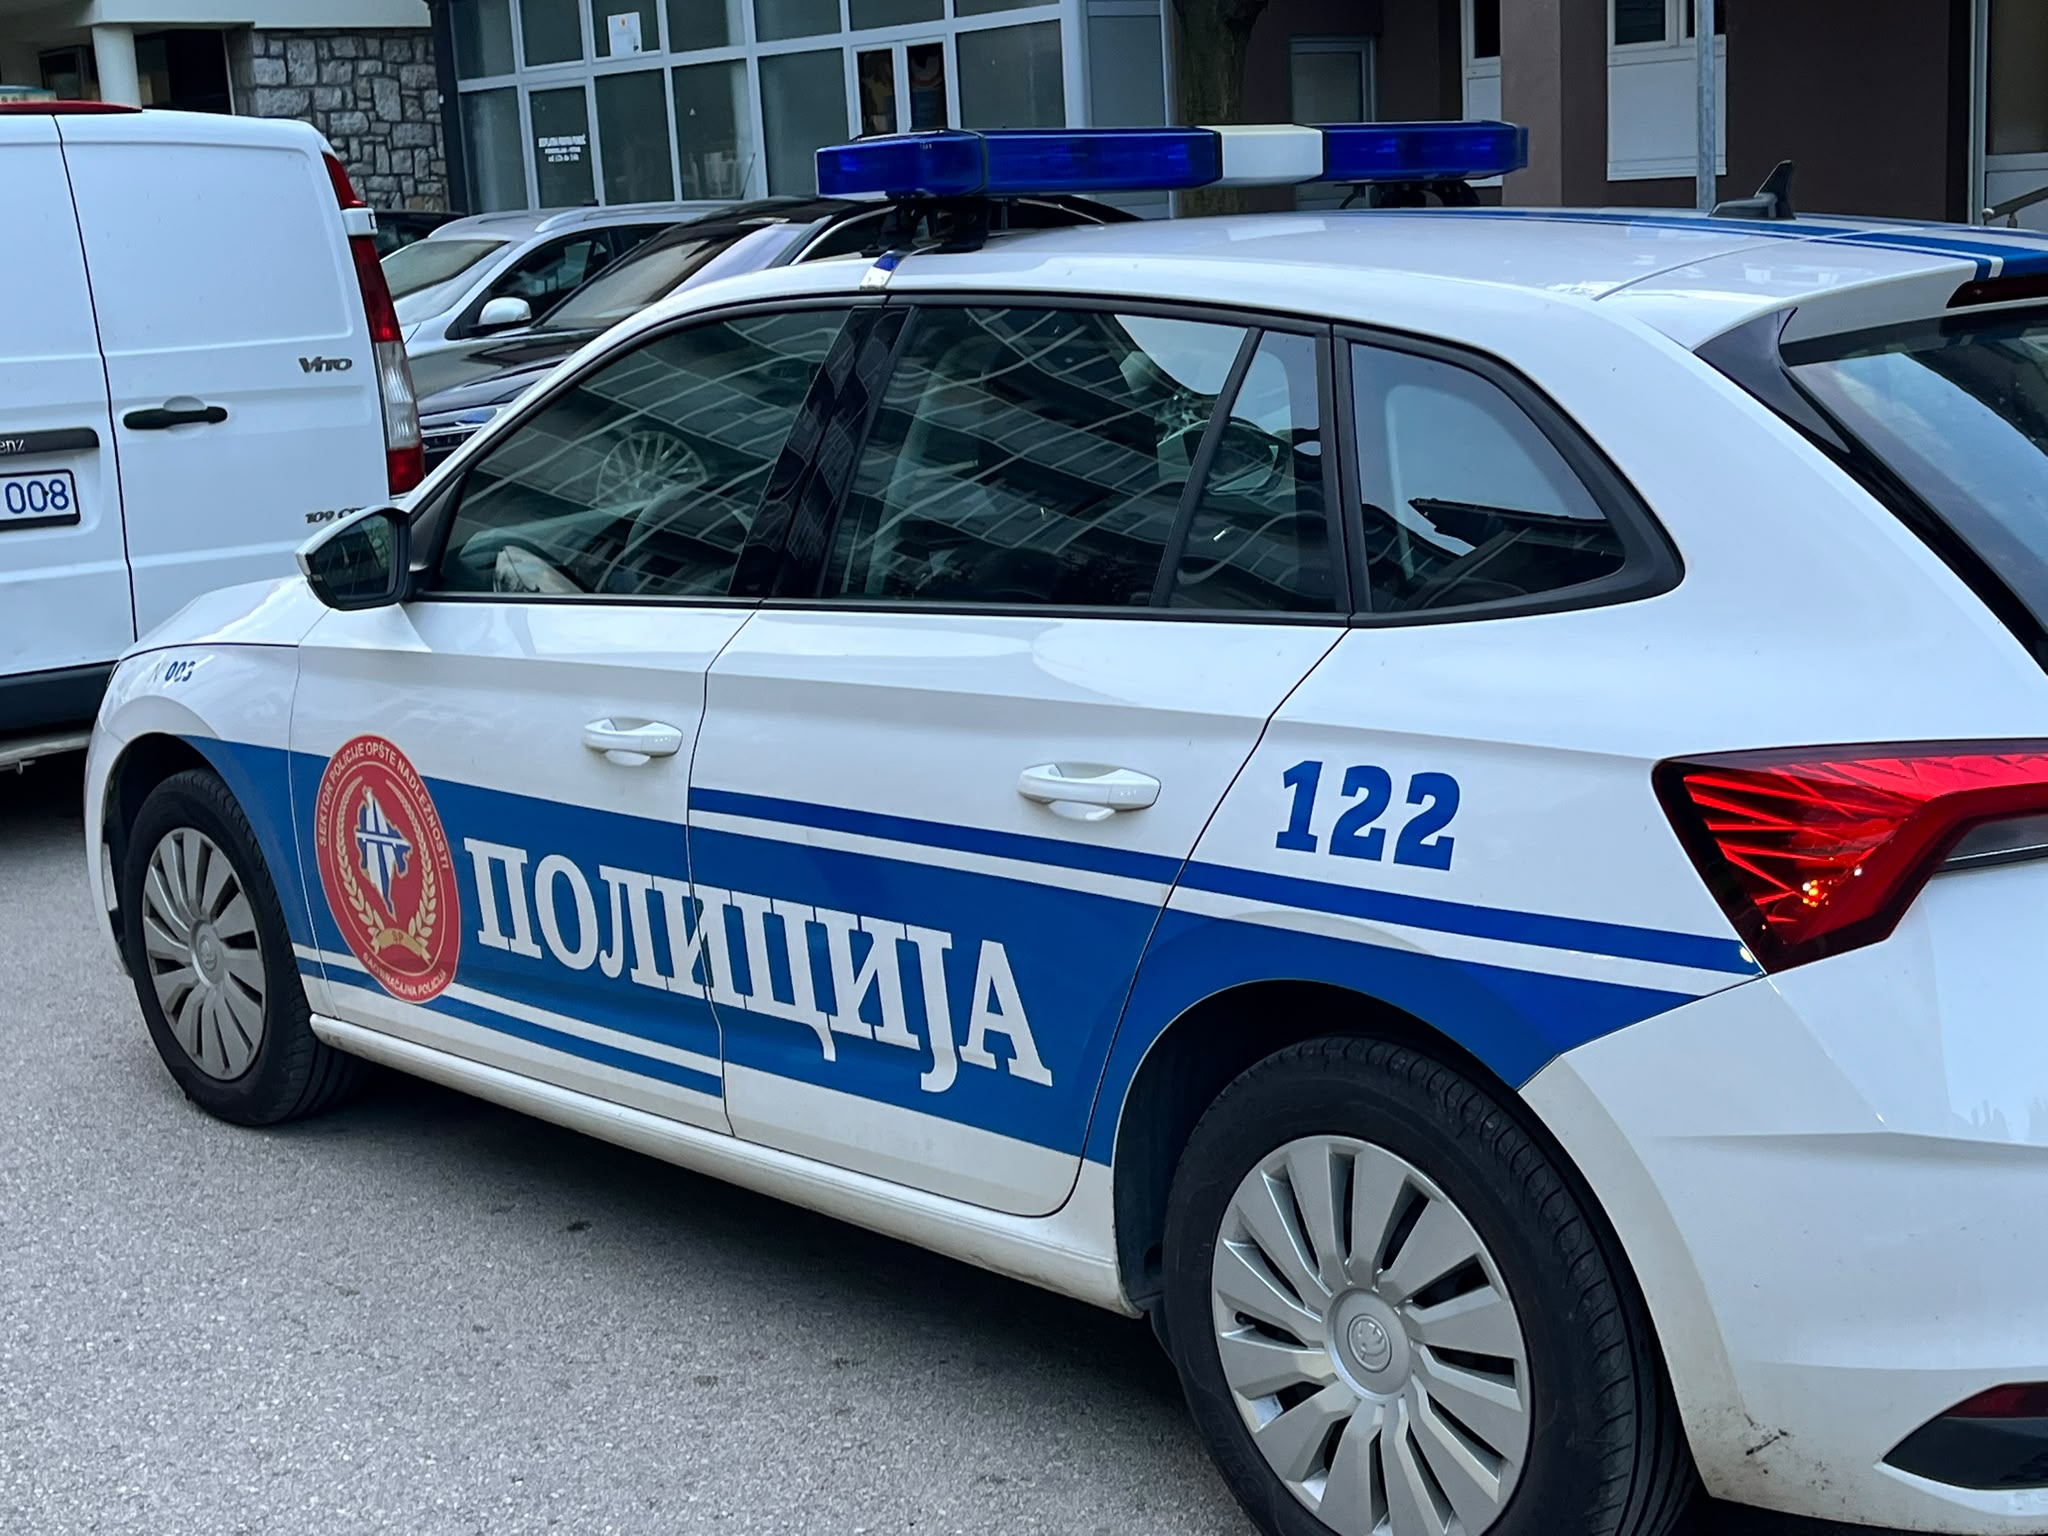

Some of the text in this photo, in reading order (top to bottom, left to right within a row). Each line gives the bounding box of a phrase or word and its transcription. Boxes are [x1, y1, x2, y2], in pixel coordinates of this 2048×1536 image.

[4, 478, 70, 515] 008
[305, 510, 335, 524] 109
[318, 782, 334, 848] SEKTOR
[329, 743, 365, 785] POLICIJE
[365, 740, 397, 766] OPŠTE
[1275, 759, 1461, 872] 122
[463, 836, 1053, 1093] ПОЛИЦИЈА
